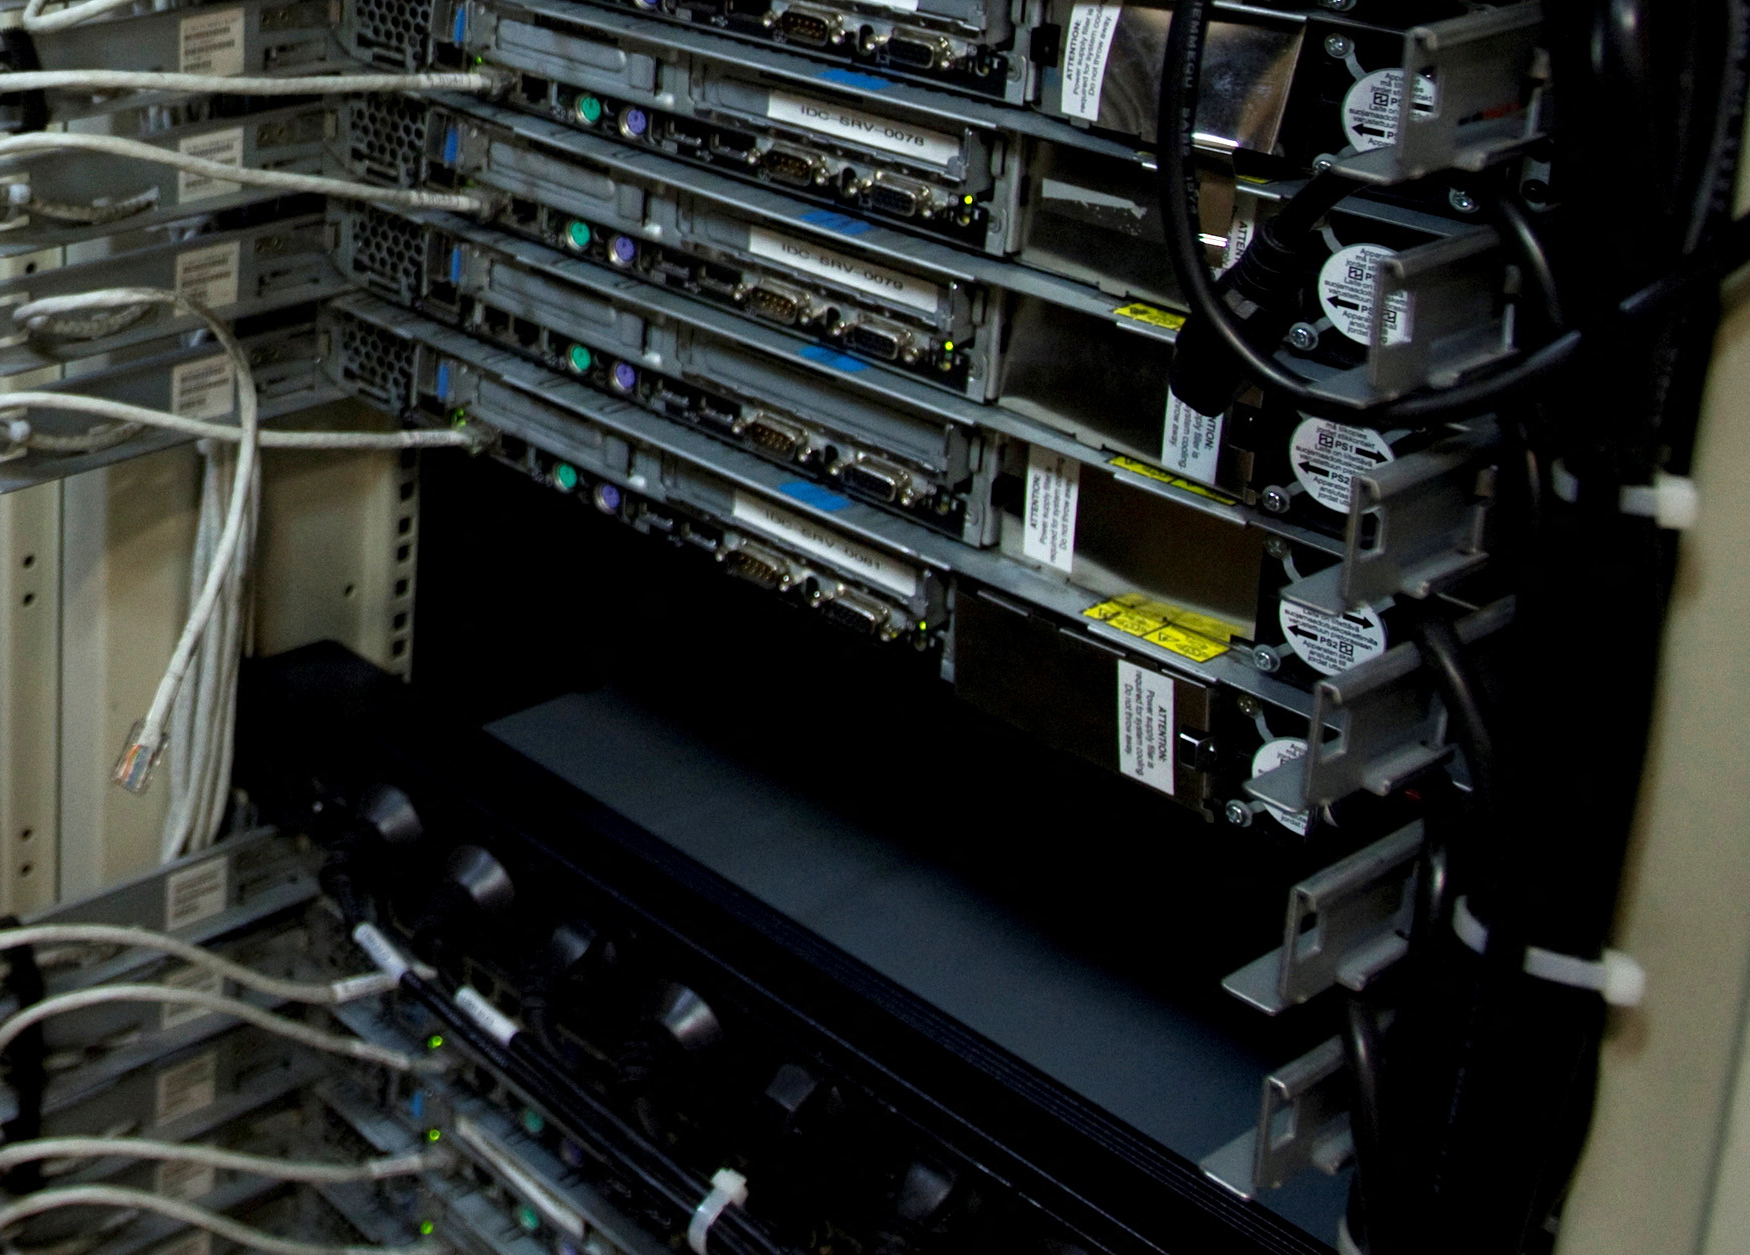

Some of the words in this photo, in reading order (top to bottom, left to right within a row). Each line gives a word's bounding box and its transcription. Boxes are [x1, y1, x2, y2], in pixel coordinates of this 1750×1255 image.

[1066, 20, 1081, 81] ATTENTION:
[1076, 36, 1089, 67] supply
[1086, 30, 1098, 61] system
[1093, 40, 1104, 65] throw
[1073, 67, 1082, 95] Power
[1083, 62, 1091, 75] for
[1091, 66, 1099, 82] not
[1080, 76, 1089, 113] required
[1088, 82, 1096, 97] Do
[800, 104, 925, 147] IDC-SRV-0078
[1335, 440, 1353, 453] PS1
[1331, 472, 1350, 486] PS2
[1030, 474, 1041, 529] ATTENTION:
[1319, 636, 1339, 650] PS2
[1125, 682, 1134, 695] Do
[1135, 670, 1144, 705] required
[1125, 696, 1133, 710] not
[1136, 705, 1144, 717] for
[1146, 689, 1155, 716] Power
[1125, 710, 1133, 733] throw
[1134, 716, 1144, 746] system
[1145, 716, 1155, 744] supply
[1158, 705, 1168, 763] ATTENTION:
